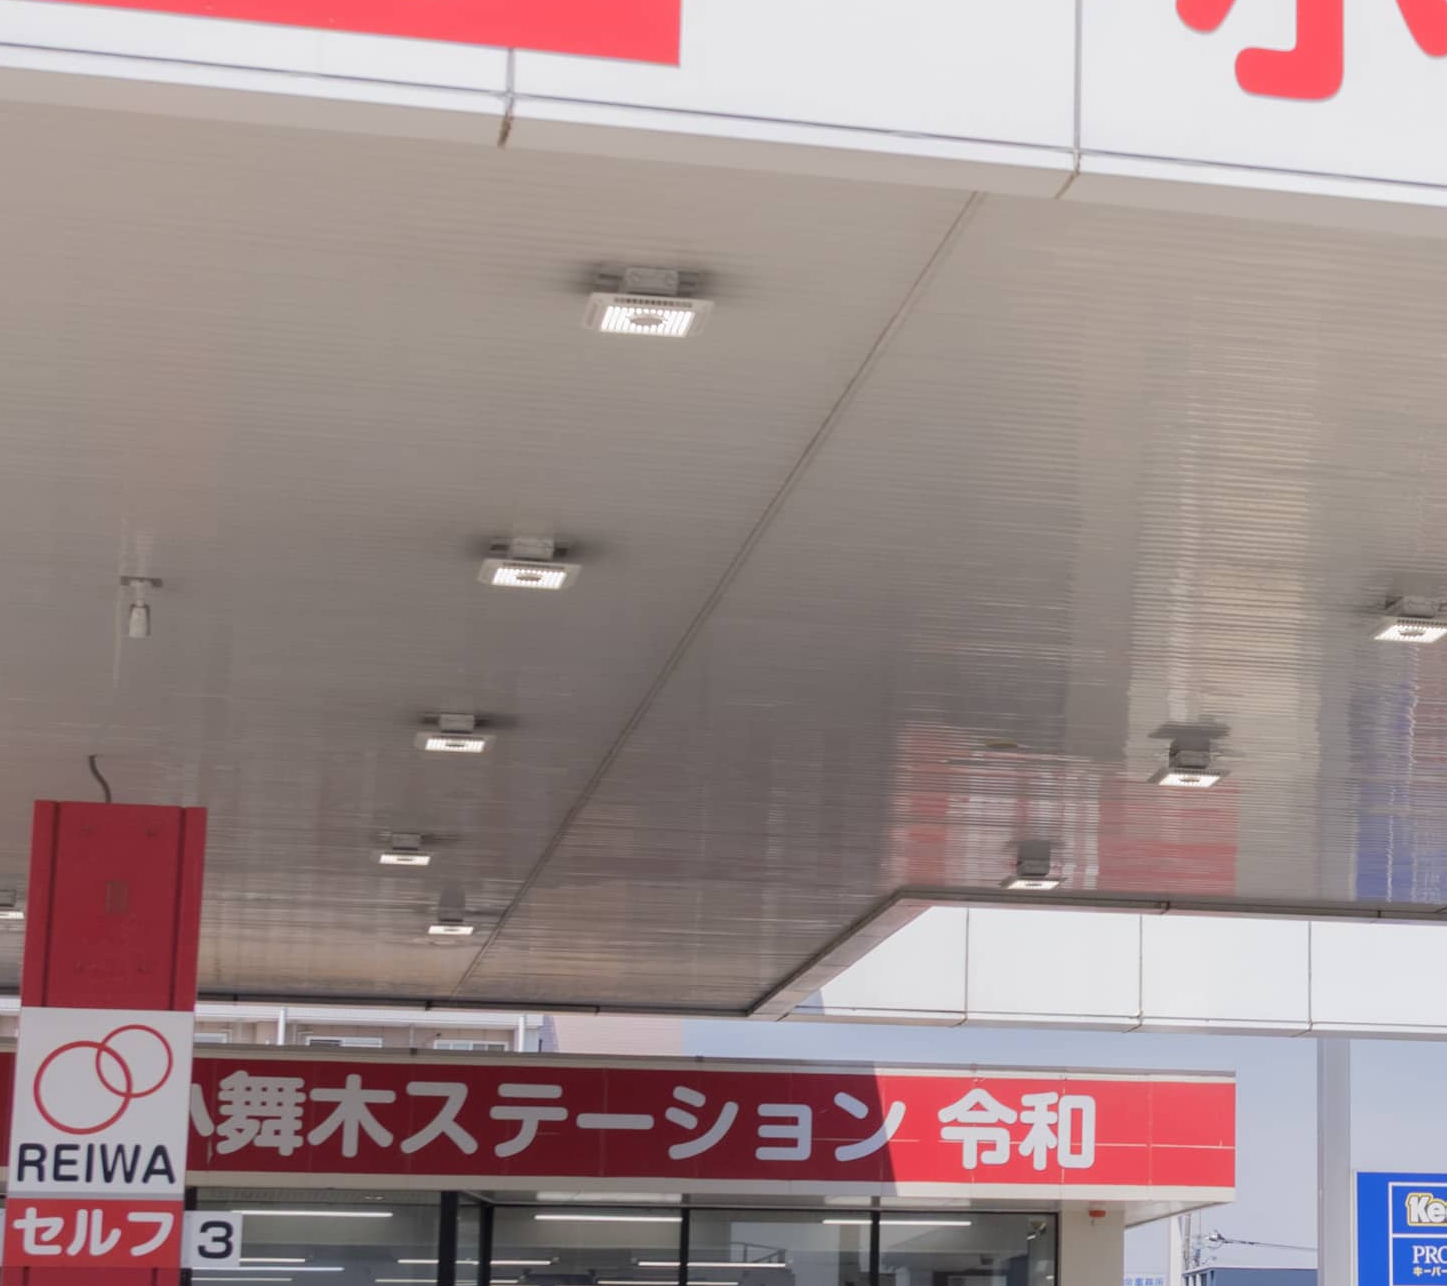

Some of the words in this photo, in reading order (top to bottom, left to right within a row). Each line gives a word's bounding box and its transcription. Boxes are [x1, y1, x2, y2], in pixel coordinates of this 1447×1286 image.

[937, 1087, 1097, 1171] 令和
[16, 1142, 176, 1185] REIWA
[12, 1207, 175, 1257] セルフ
[197, 1220, 235, 1260] 3
